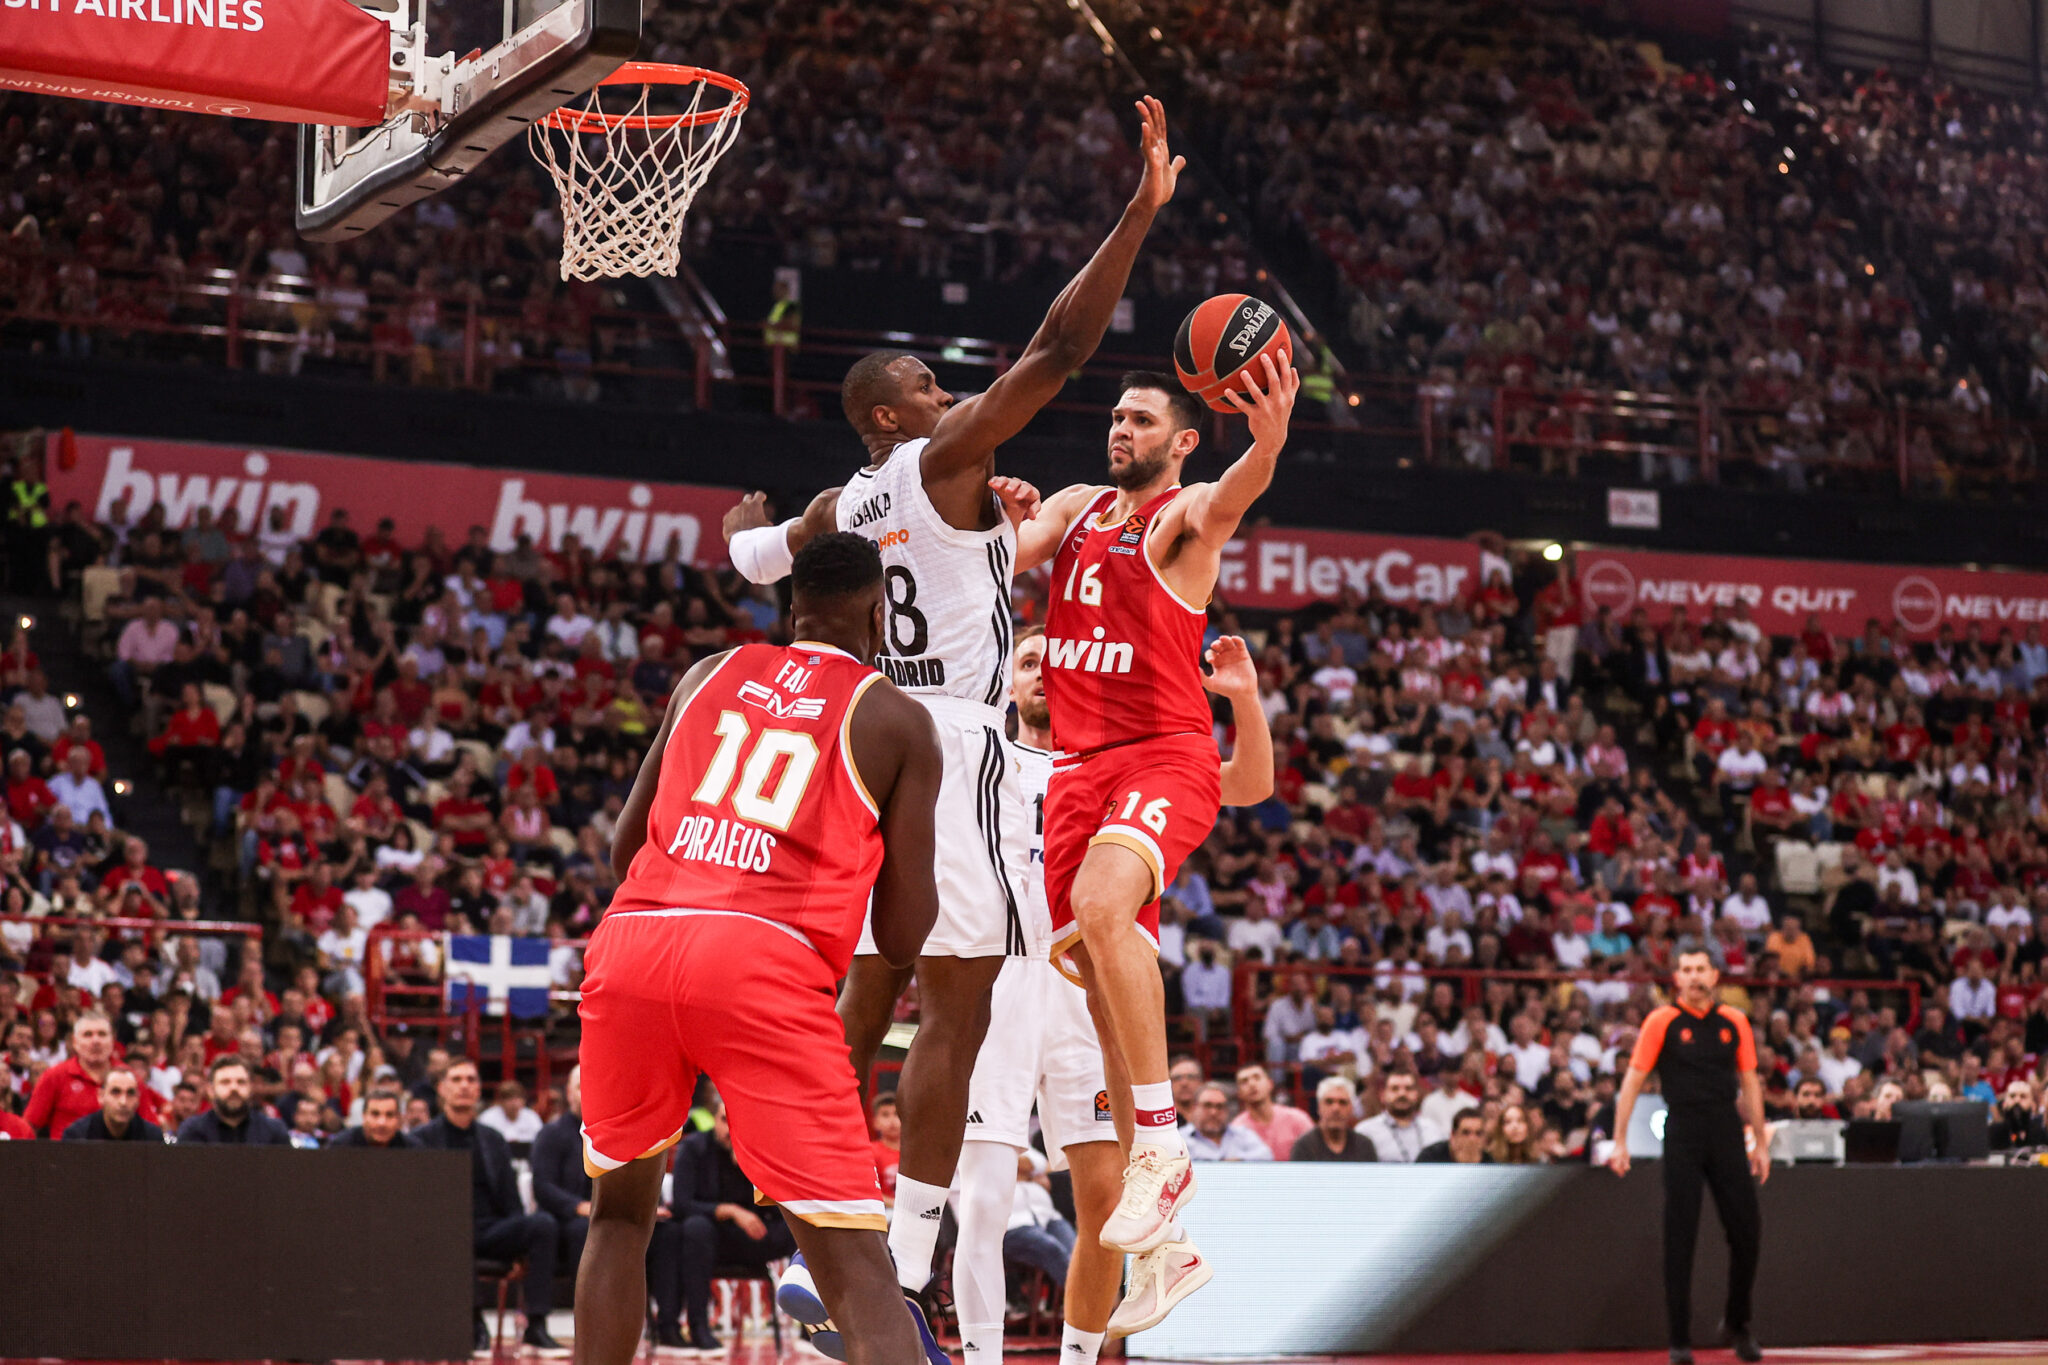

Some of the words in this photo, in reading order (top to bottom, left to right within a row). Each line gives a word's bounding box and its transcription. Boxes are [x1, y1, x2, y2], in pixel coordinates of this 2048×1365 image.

[74, 0, 264, 32] AIRLINES
[94, 447, 319, 537] bwin
[490, 478, 701, 565] bwin
[1063, 558, 1103, 607] 16
[1258, 540, 1468, 604] FlexCar
[1638, 579, 1763, 607] NEVER
[1771, 584, 1858, 616] QUIT
[879, 565, 928, 657] 8
[690, 709, 820, 832] 10
[1119, 790, 1173, 838] 16
[667, 816, 777, 873] PIRAEUS
